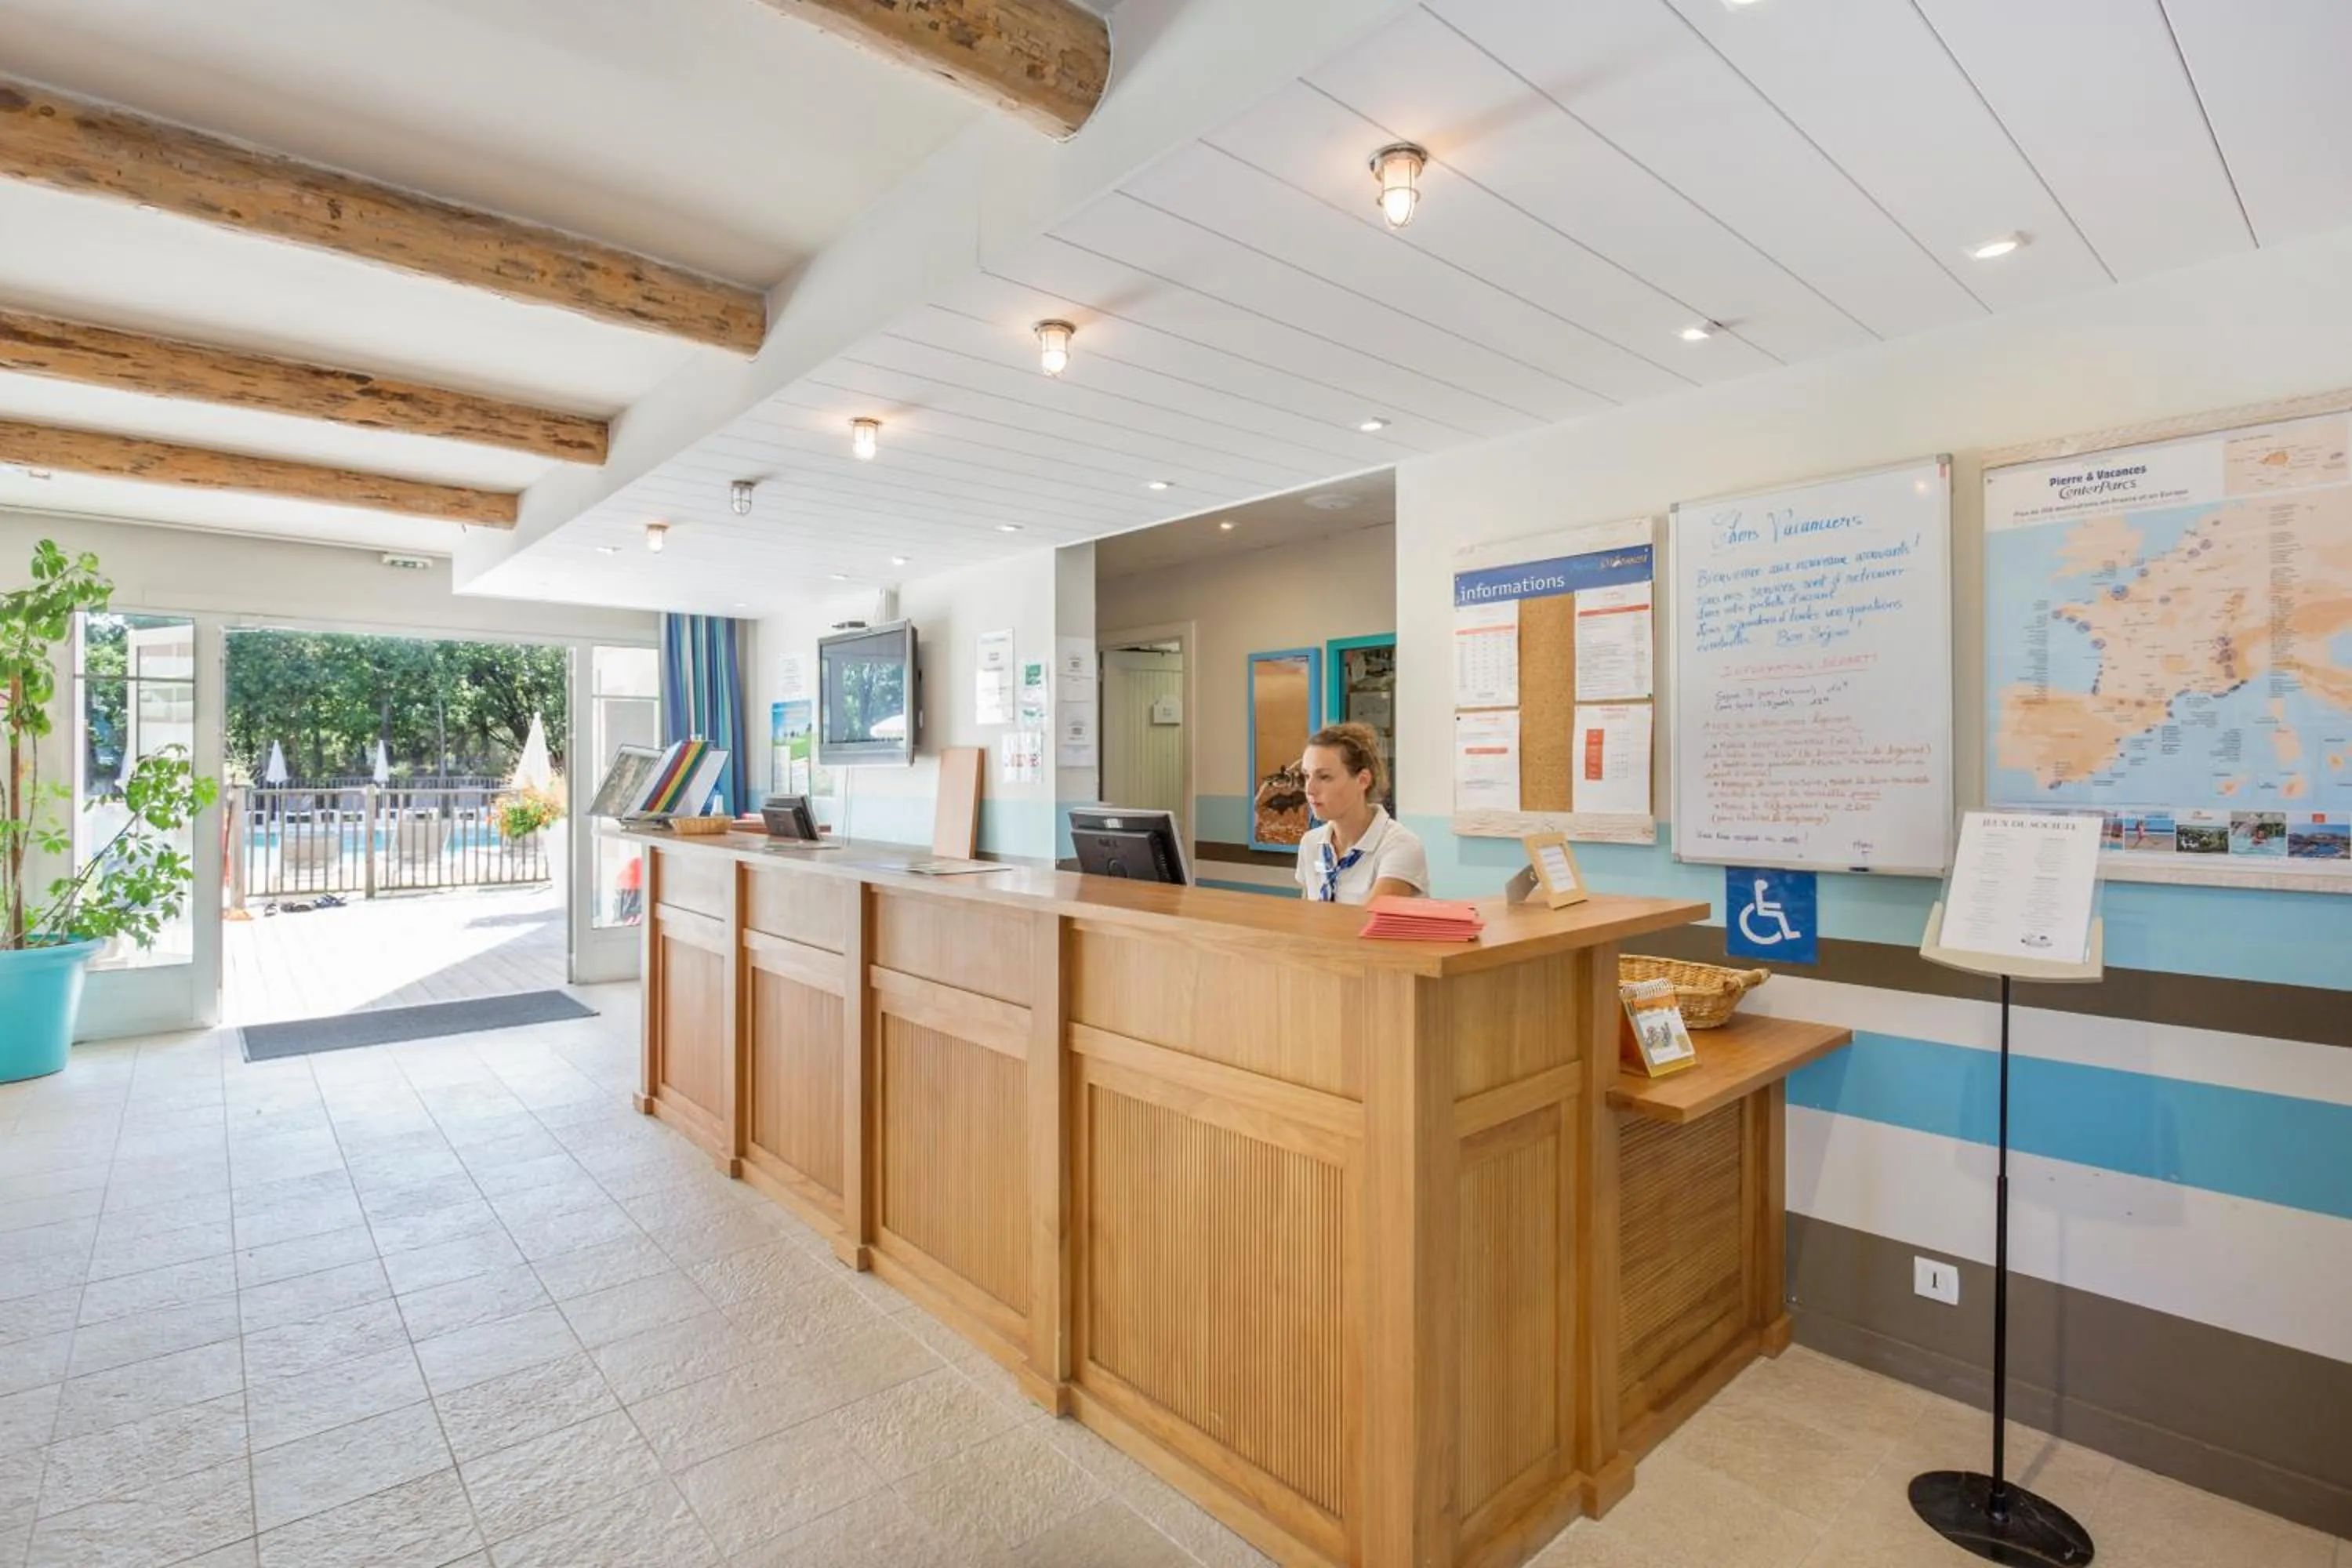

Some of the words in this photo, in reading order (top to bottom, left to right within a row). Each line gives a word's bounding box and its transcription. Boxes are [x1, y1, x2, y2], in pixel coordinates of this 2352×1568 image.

[2049, 474, 2083, 488] Pierre
[2086, 470, 2094, 481] &
[2096, 465, 2147, 481] Vacances
[1460, 575, 1566, 602] informations
